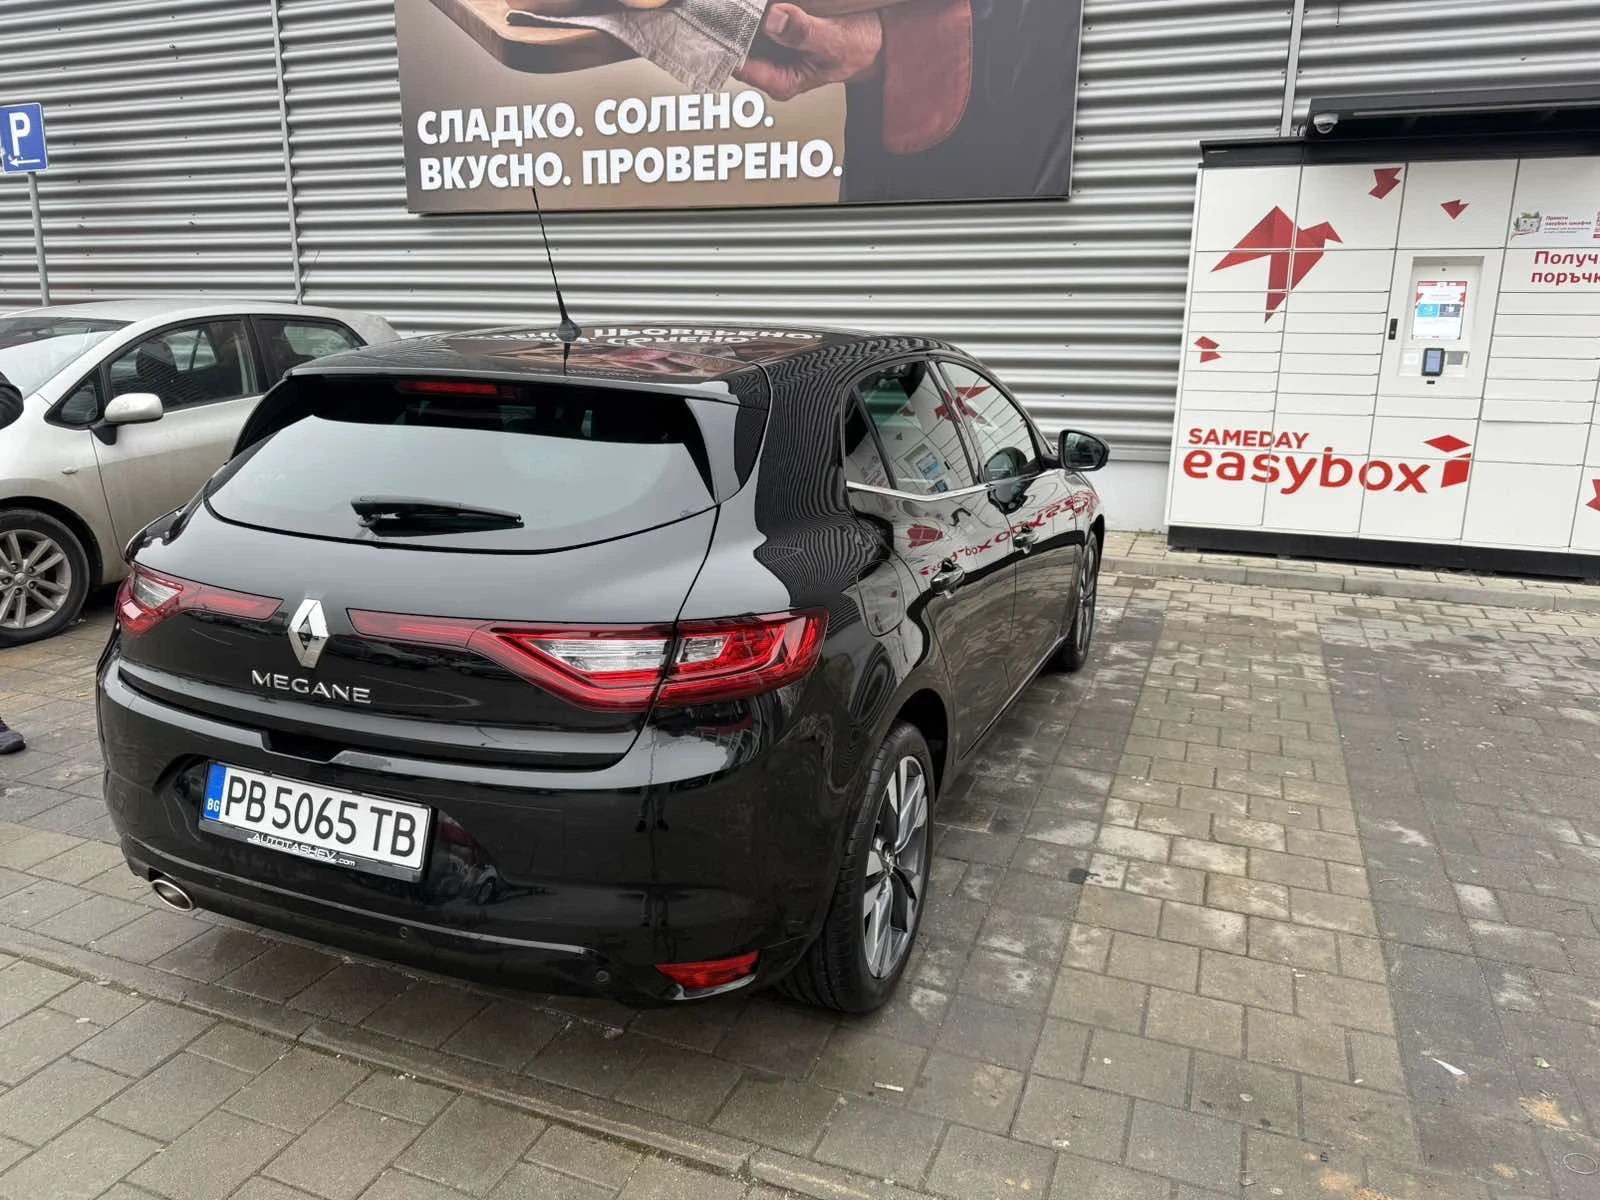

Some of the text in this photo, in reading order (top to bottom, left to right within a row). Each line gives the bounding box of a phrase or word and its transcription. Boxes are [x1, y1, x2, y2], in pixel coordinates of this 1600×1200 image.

[9, 112, 31, 156] P
[417, 89, 774, 148] СЛАДКО. СОЛЕНО.
[419, 138, 843, 190] ВКУСНО. ПРОВЕРЕНО.
[1534, 251, 1600, 268] Получ
[1188, 428, 1309, 449] SAMEDAY
[1183, 446, 1431, 495] easybox
[251, 669, 371, 704] MEGANE
[207, 798, 221, 812] BG
[225, 775, 416, 858] PB 5065 TB
